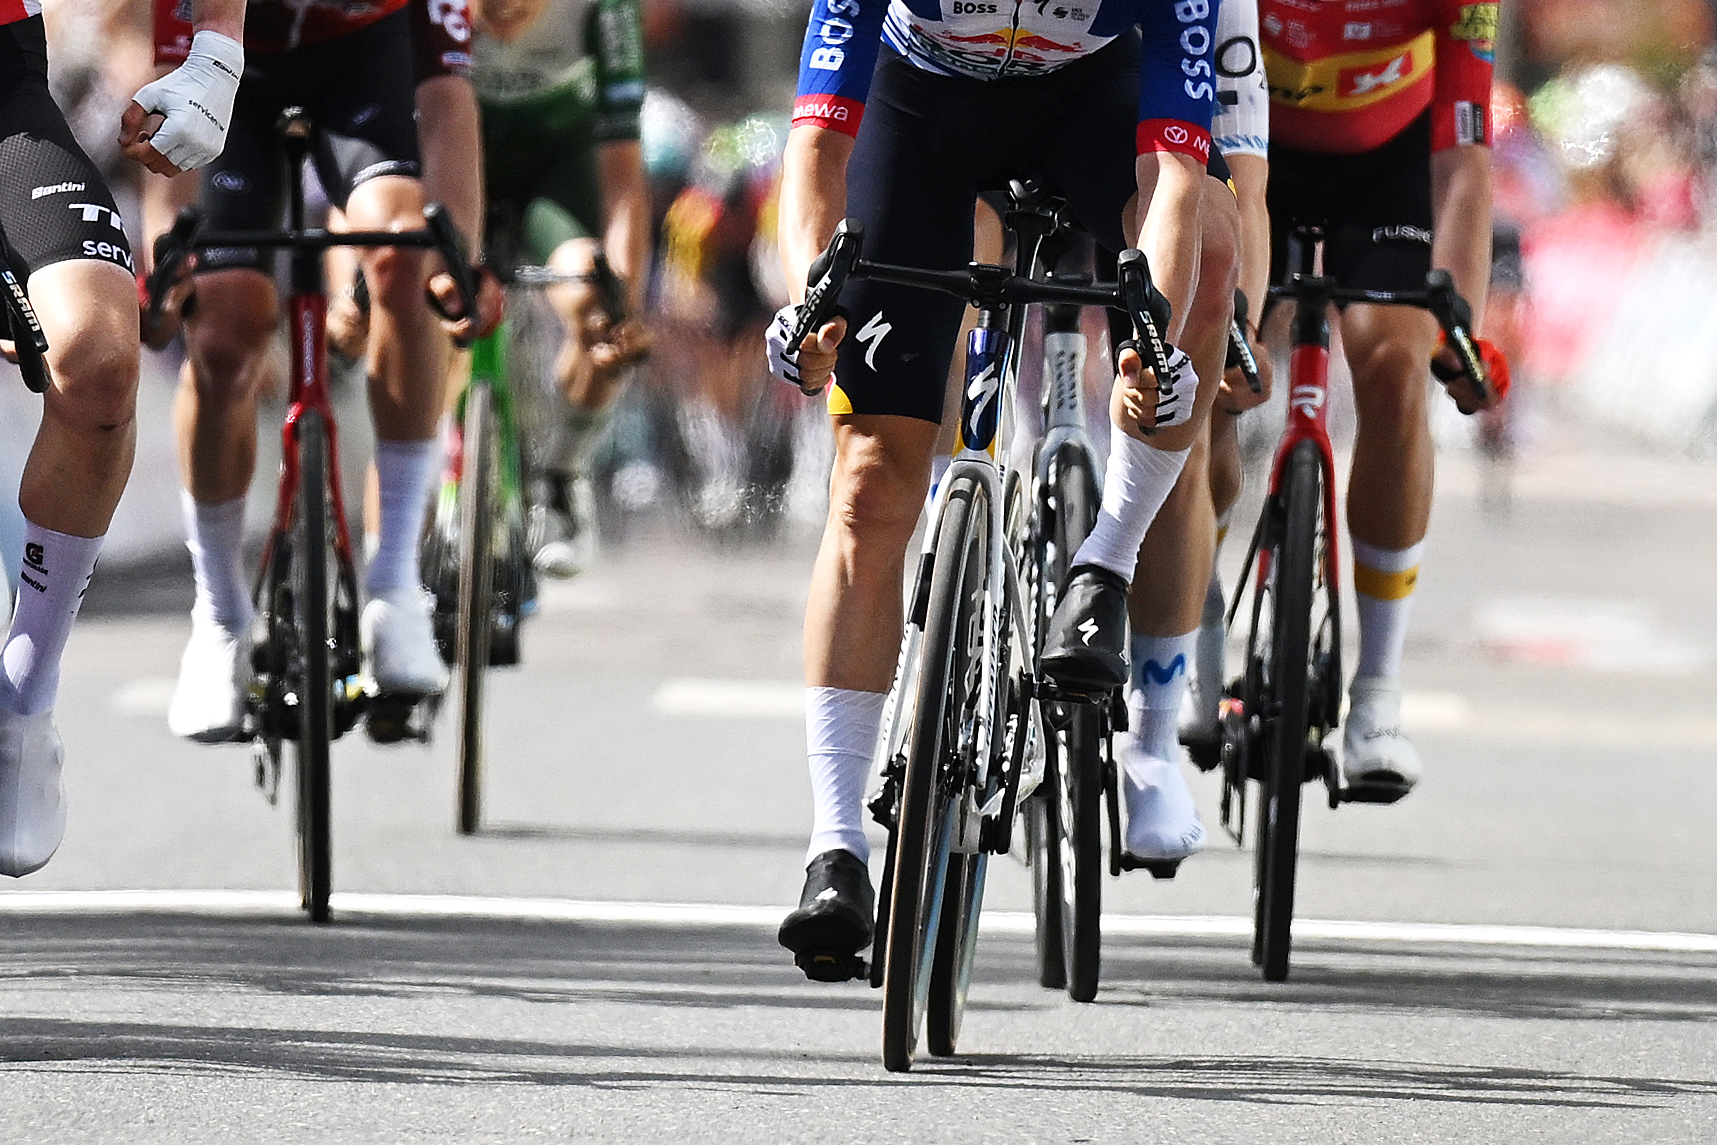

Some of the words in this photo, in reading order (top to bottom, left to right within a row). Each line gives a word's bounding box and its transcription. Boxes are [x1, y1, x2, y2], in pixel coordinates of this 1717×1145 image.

[953, 0, 998, 15] BOSS
[188, 98, 226, 134] servicenow
[31, 181, 86, 200] Santini
[1, 270, 41, 332] SRAM
[1138, 309, 1170, 373] SRAM
